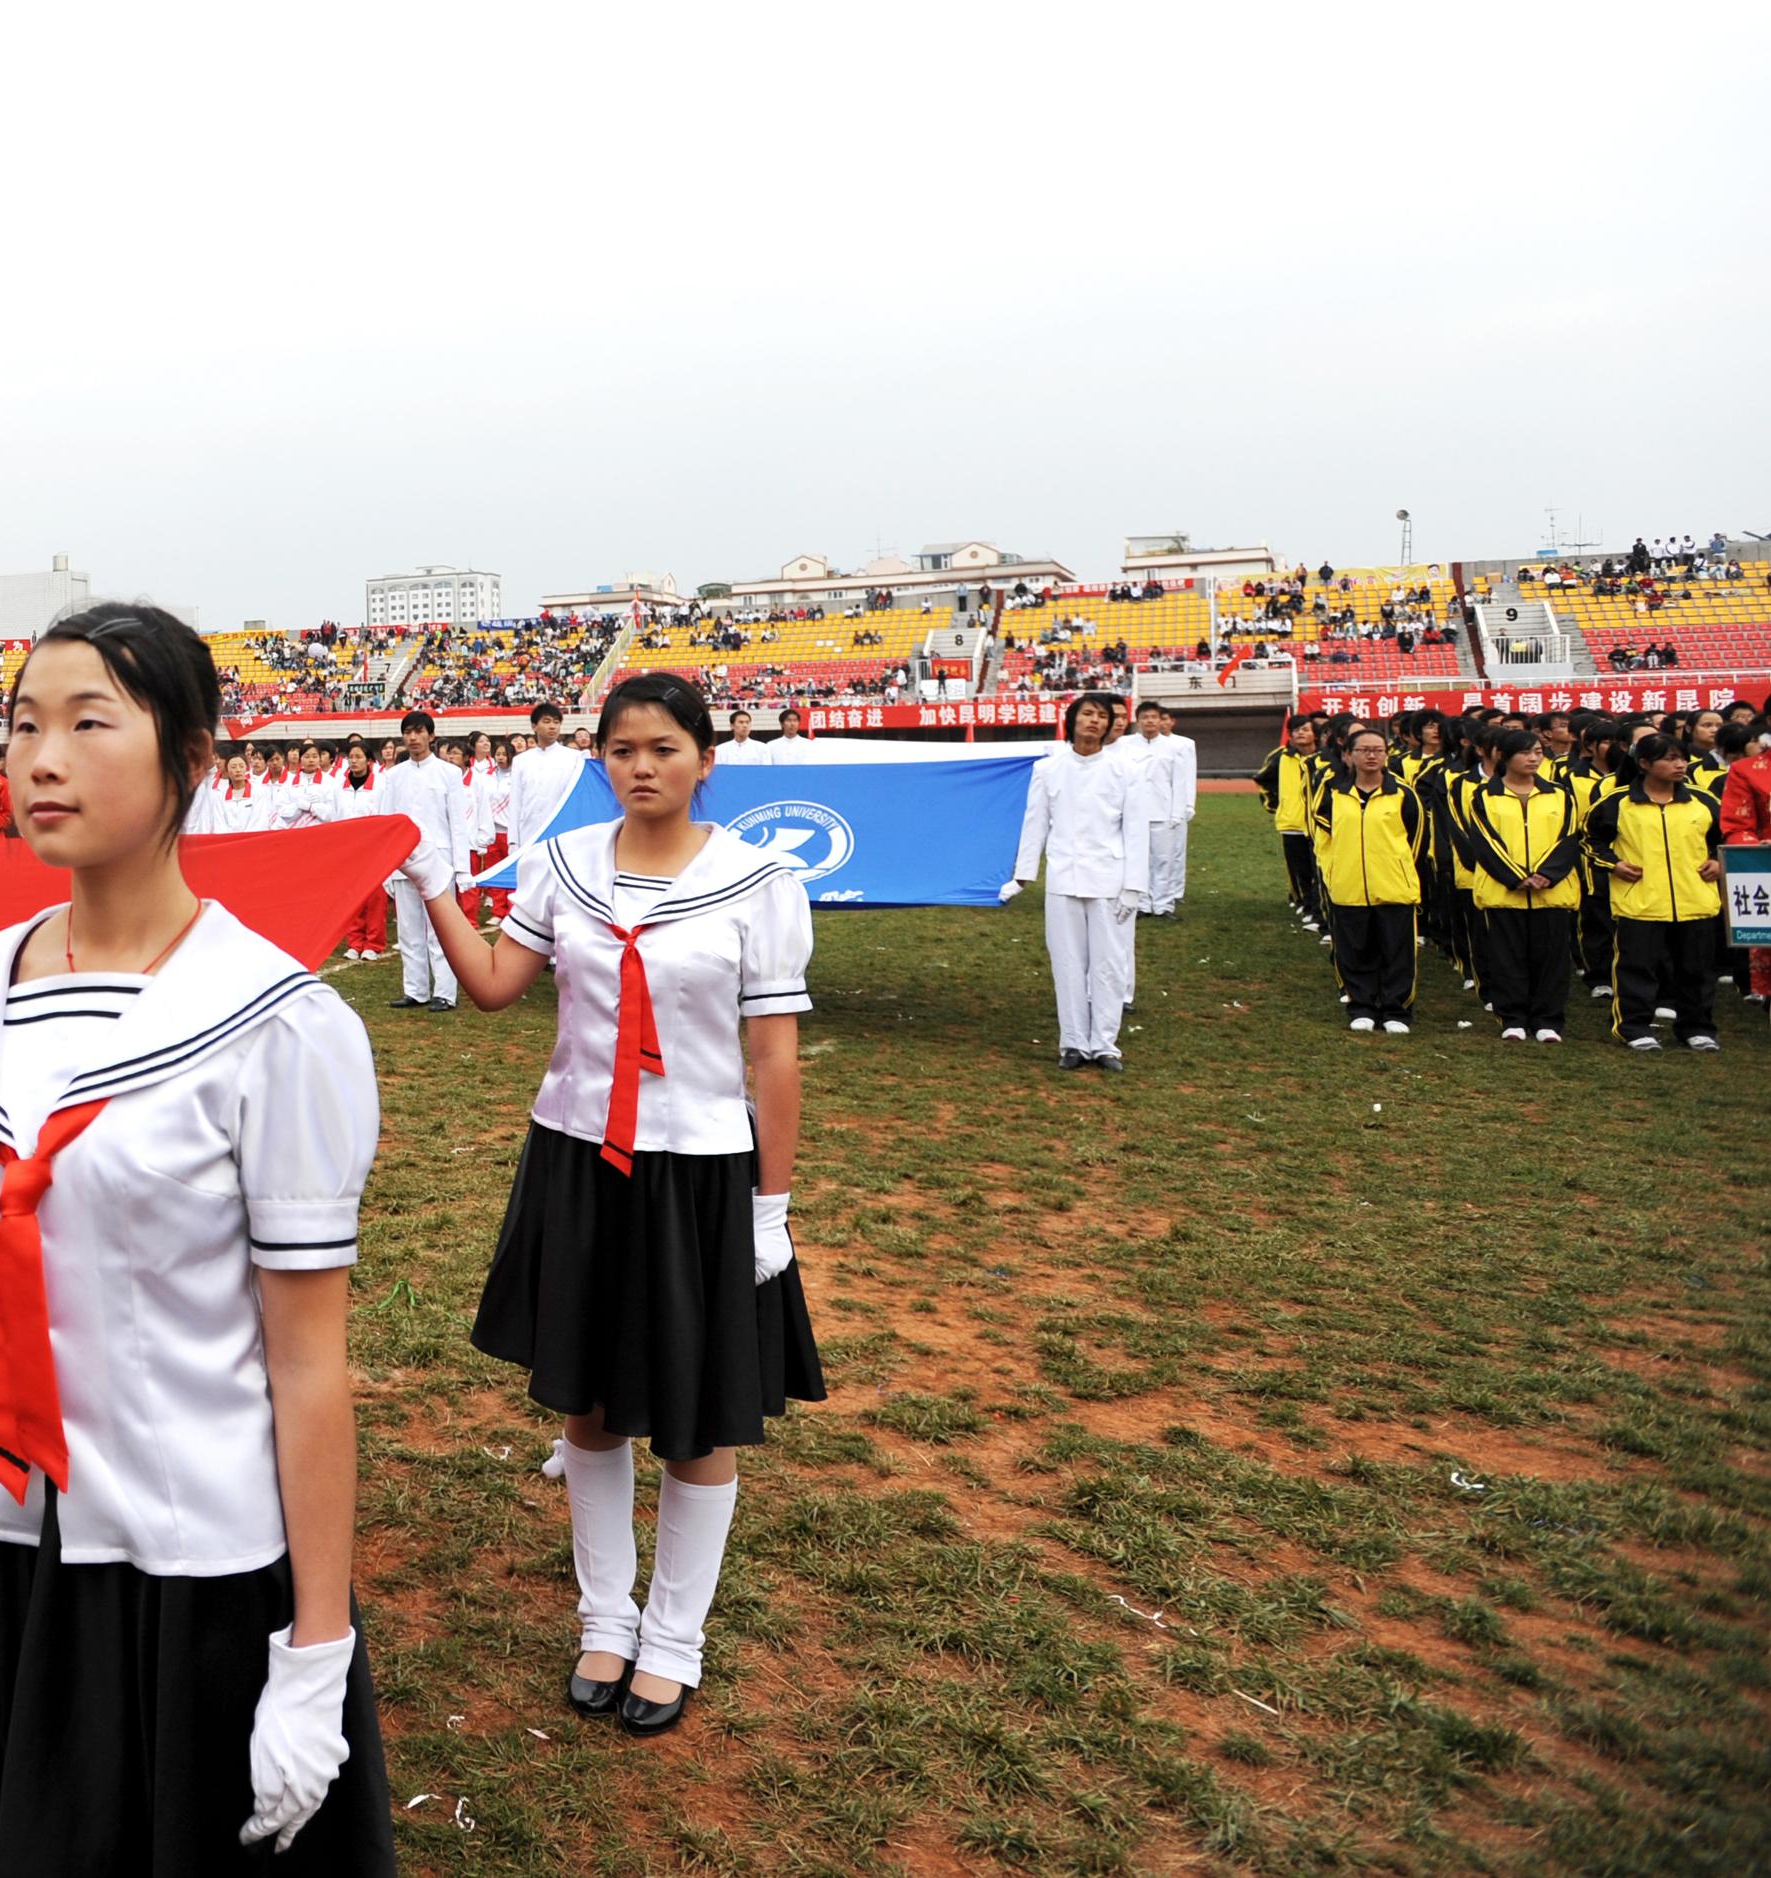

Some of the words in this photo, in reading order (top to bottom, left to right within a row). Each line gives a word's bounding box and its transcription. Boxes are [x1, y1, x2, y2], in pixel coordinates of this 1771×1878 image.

[1506, 608, 1518, 621] 9
[955, 634, 964, 646] 8
[385, 663, 391, 673] 7
[810, 708, 883, 729] 团结奋进
[737, 806, 782, 831] KUNMING
[785, 805, 838, 830] UNIVERSITY
[1733, 884, 1770, 917] 社会
